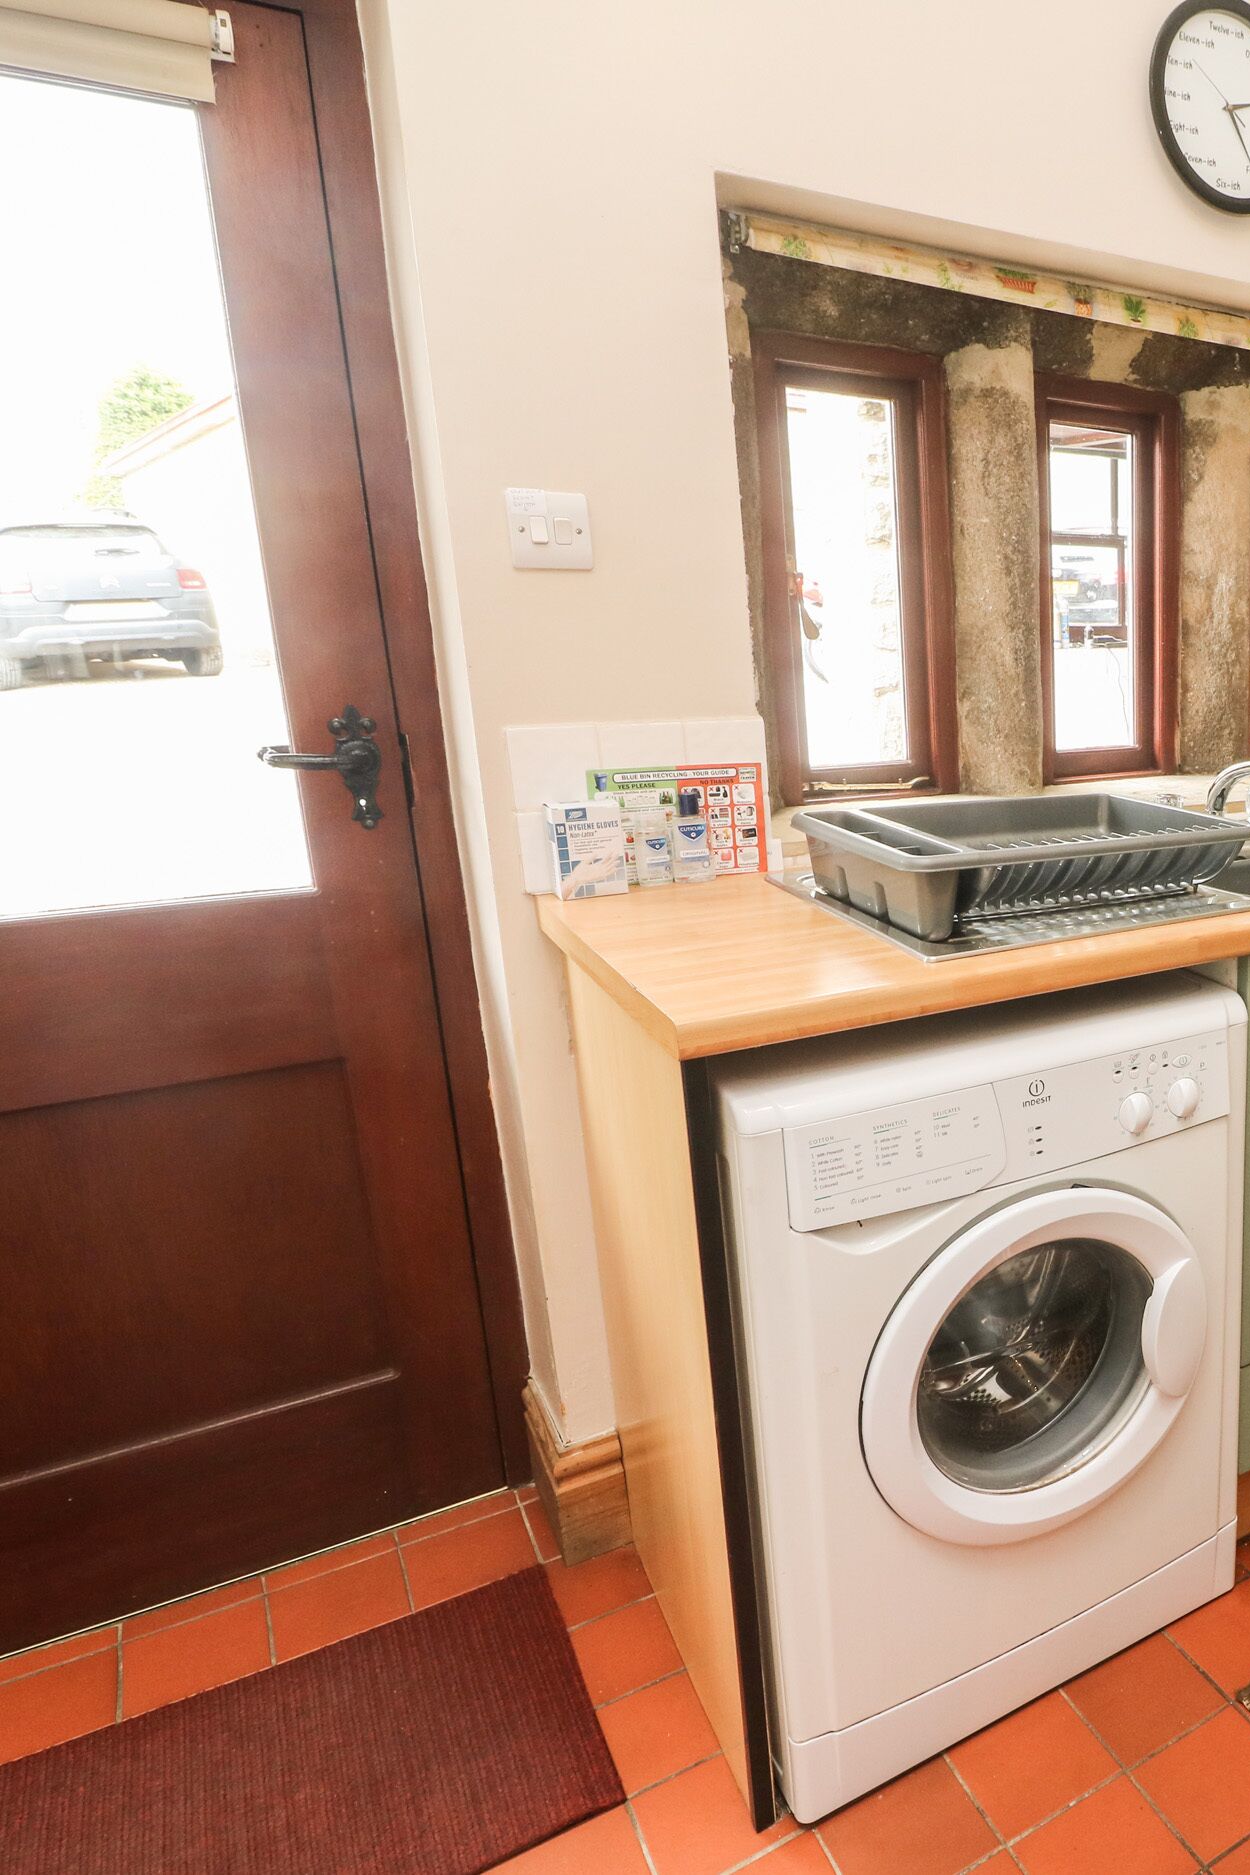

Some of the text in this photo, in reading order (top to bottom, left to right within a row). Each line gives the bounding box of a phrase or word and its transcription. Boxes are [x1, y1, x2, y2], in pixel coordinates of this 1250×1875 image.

[1209, 21, 1245, 40] Twelve-ish
[1179, 31, 1215, 49] Eleven-ish
[1167, 55, 1193, 69] Ten-ish
[1164, 87, 1191, 101] ine-ish
[1216, 178, 1241, 191] Six-ish
[652, 771, 688, 779] RECYCLING
[568, 820, 619, 831] HYGIENE GLOVES
[872, 1119, 907, 1131] SYNTHETICS
[808, 1136, 834, 1145] COTTON
